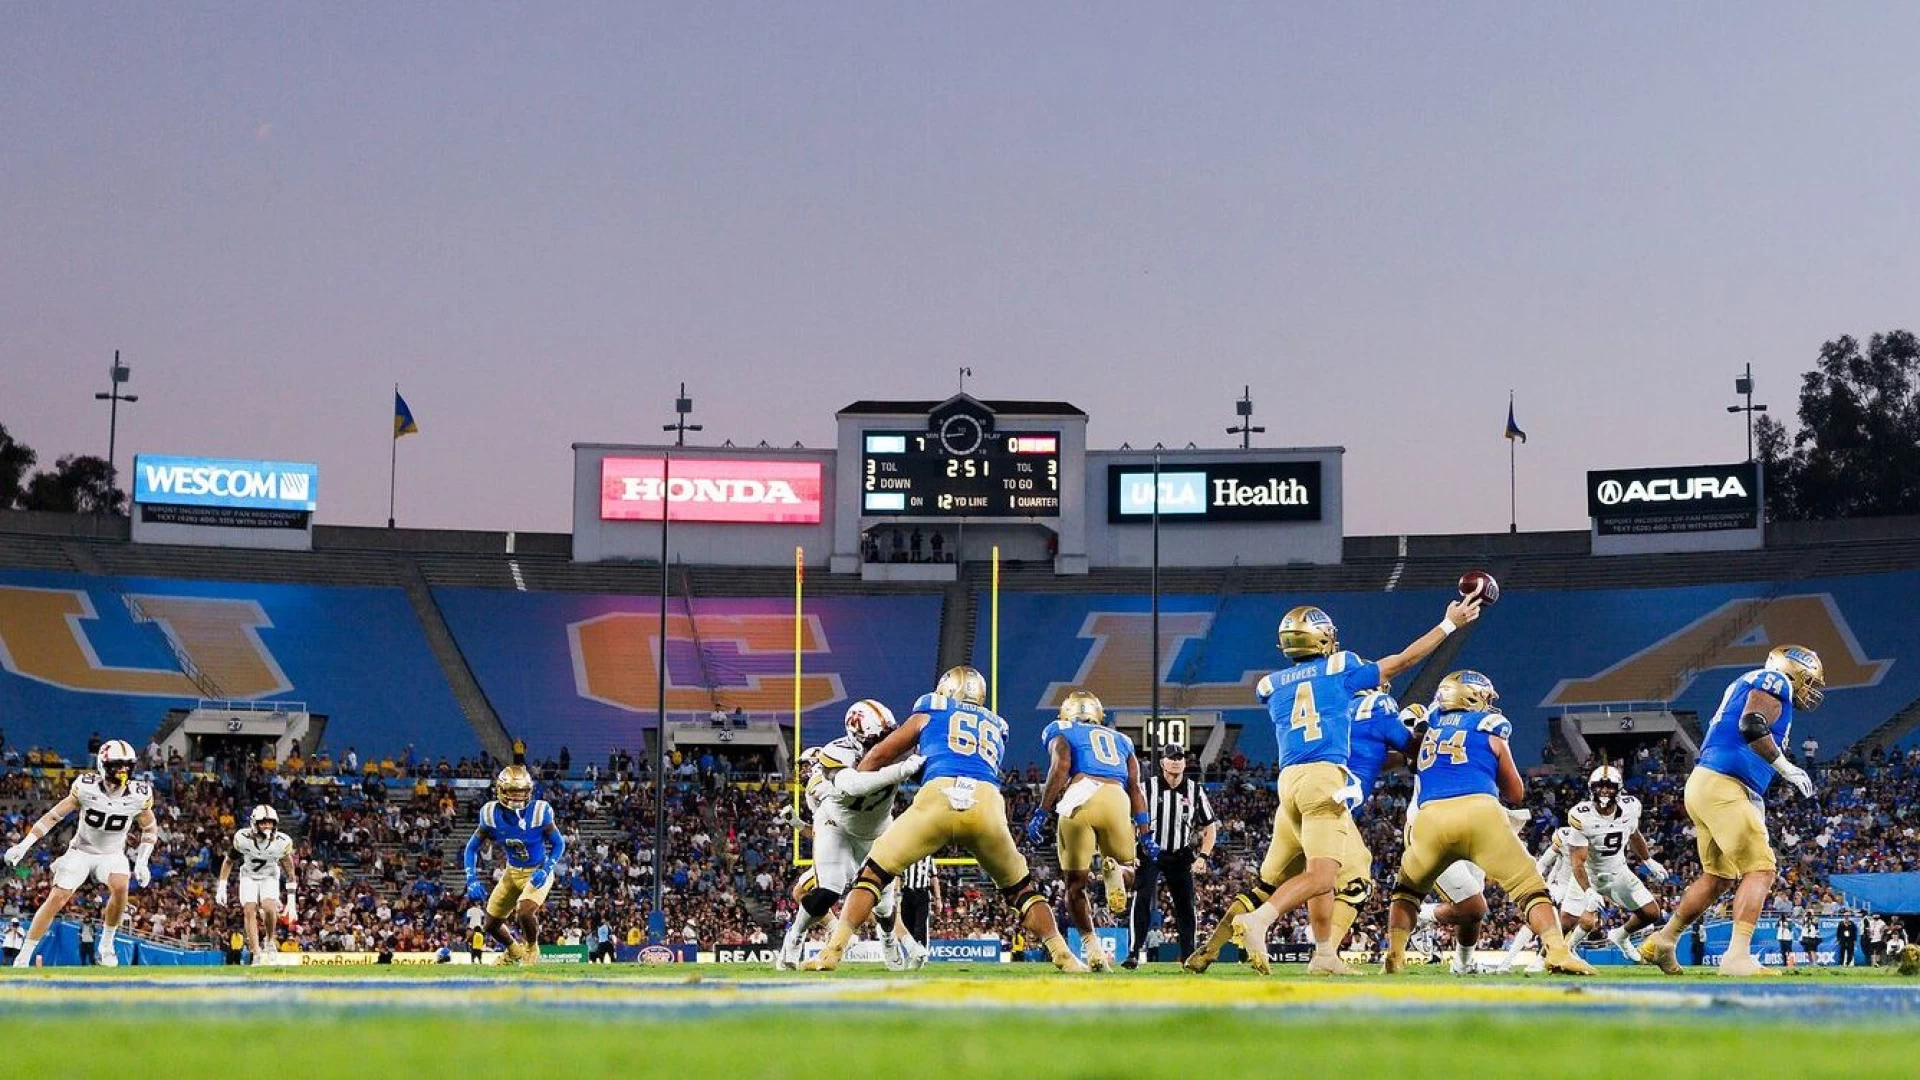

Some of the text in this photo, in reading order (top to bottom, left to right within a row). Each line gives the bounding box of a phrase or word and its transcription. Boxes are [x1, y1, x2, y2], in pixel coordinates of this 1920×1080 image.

[916, 437, 925, 452] 7
[1008, 437, 1018, 453] 0
[866, 459, 898, 475] 3 TOL
[1016, 459, 1057, 475] TOL 3
[145, 465, 277, 499] WESCOM
[621, 477, 801, 504] HONDA
[865, 475, 911, 491] 2 DOWN
[1002, 476, 1057, 491] TO GO 7
[1622, 476, 1748, 504] ACURA
[1212, 478, 1309, 506] Health
[910, 497, 924, 507] ON
[937, 494, 953, 510] 12
[954, 497, 967, 507] YD
[968, 497, 989, 507] LINE
[1018, 497, 1059, 508] QUARTER
[1762, 673, 1785, 695] 54
[1290, 681, 1323, 742] 4
[948, 710, 999, 773] 66
[1089, 728, 1121, 767] 0
[1417, 727, 1469, 772] 64
[1600, 831, 1624, 857] 9
[250, 858, 267, 873] 7
[928, 946, 983, 958] WESCOM
[1265, 952, 1310, 962] NISS
